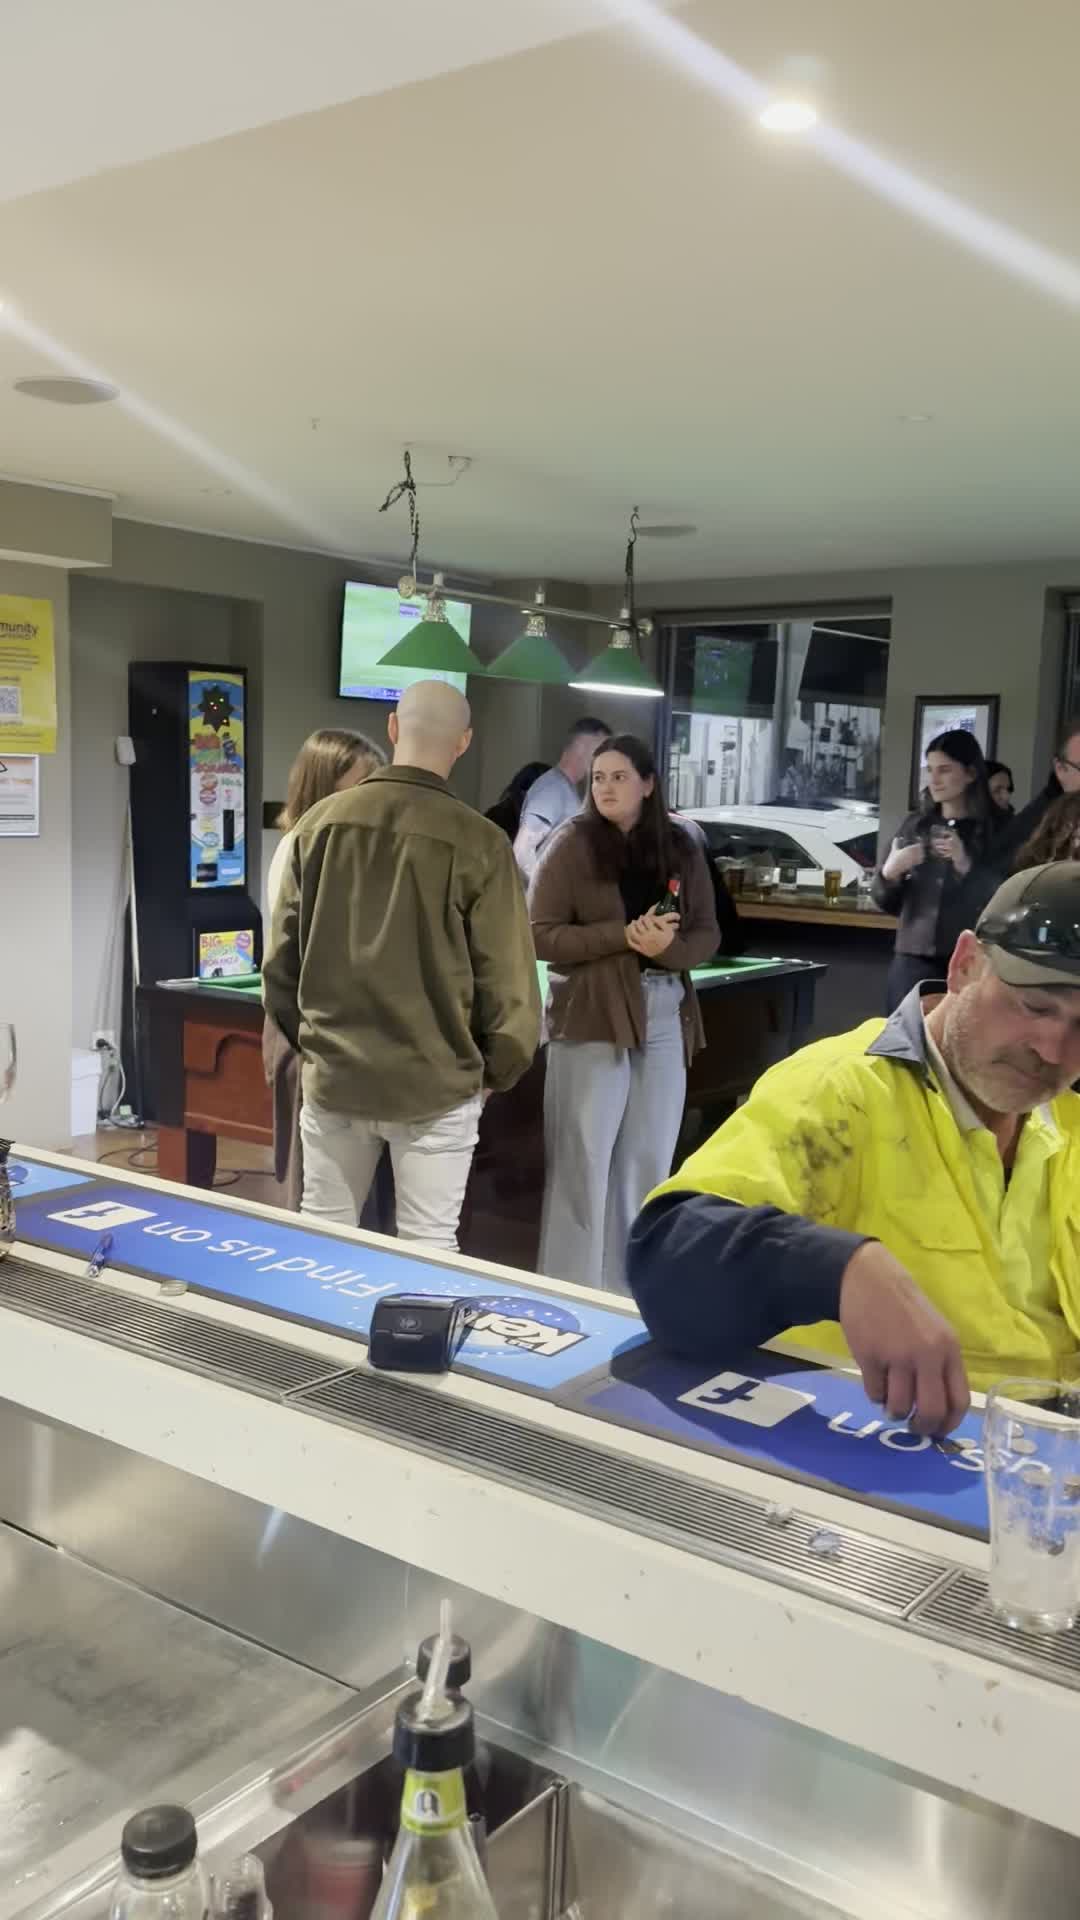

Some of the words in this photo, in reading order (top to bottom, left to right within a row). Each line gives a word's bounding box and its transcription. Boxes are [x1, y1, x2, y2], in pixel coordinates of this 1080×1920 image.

[144, 1221, 212, 1243] on
[207, 1238, 276, 1261] us
[256, 1255, 396, 1298] Find
